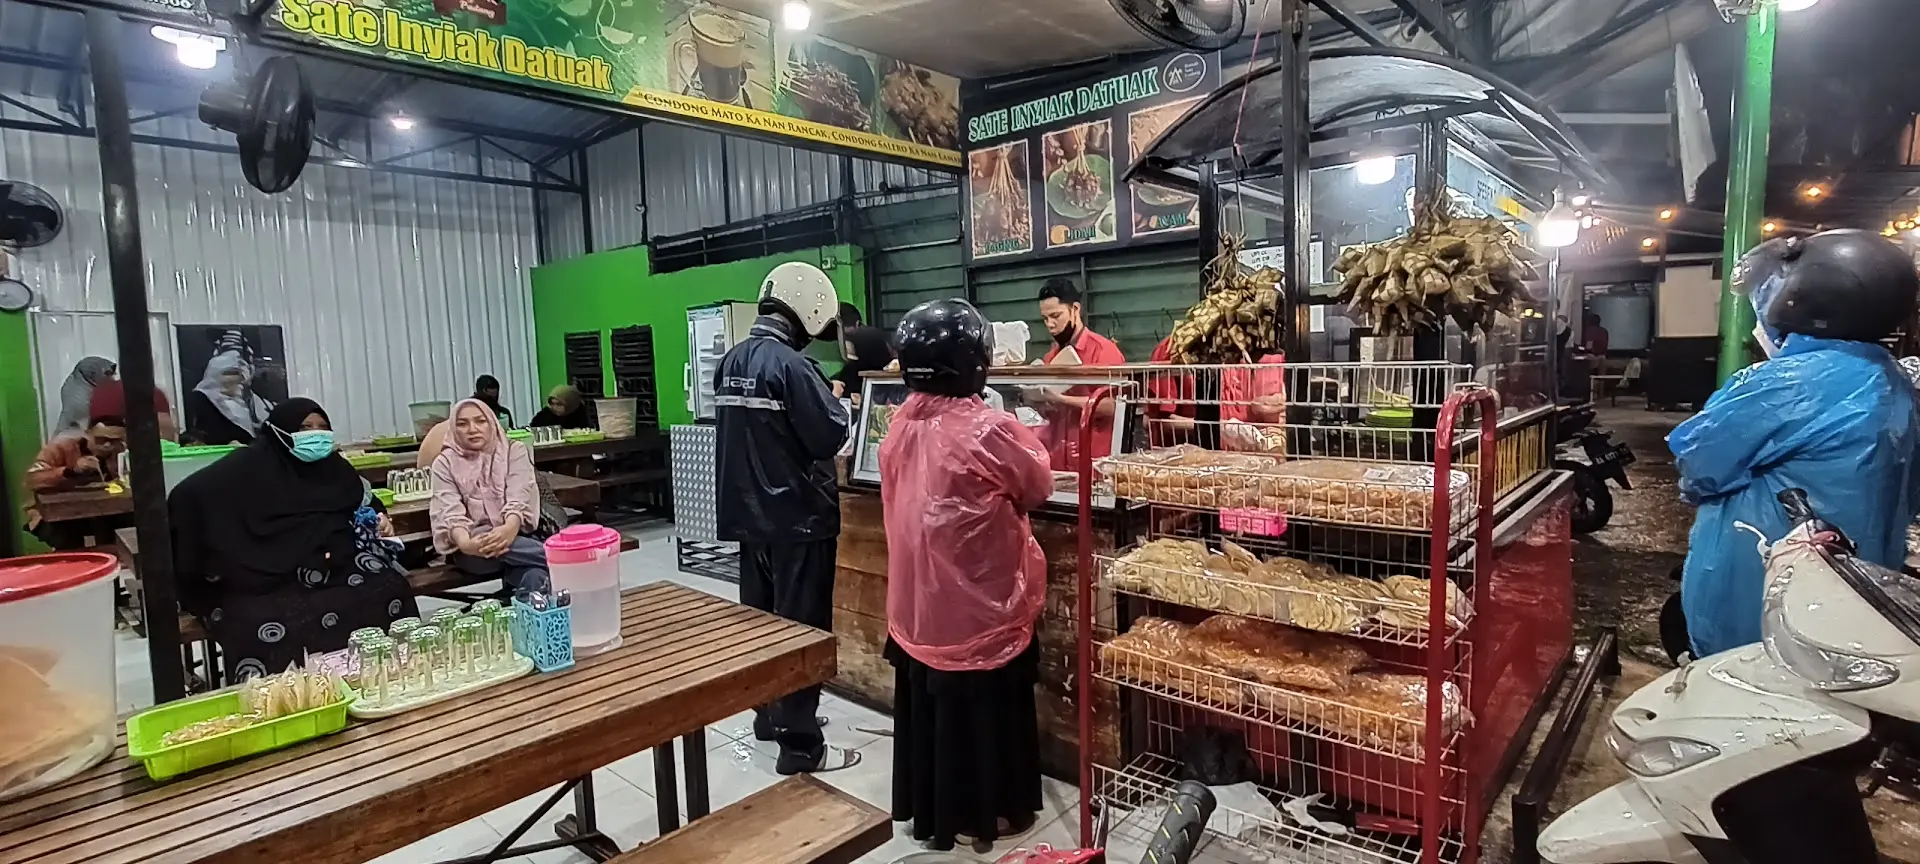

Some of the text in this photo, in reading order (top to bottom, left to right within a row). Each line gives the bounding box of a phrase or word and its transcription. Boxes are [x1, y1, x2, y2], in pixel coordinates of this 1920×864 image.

[281, 0, 616, 94] Sate Inyiak Datuak
[711, 107, 744, 122] MATO
[968, 66, 1161, 142] SATE INYIAK DATUAK
